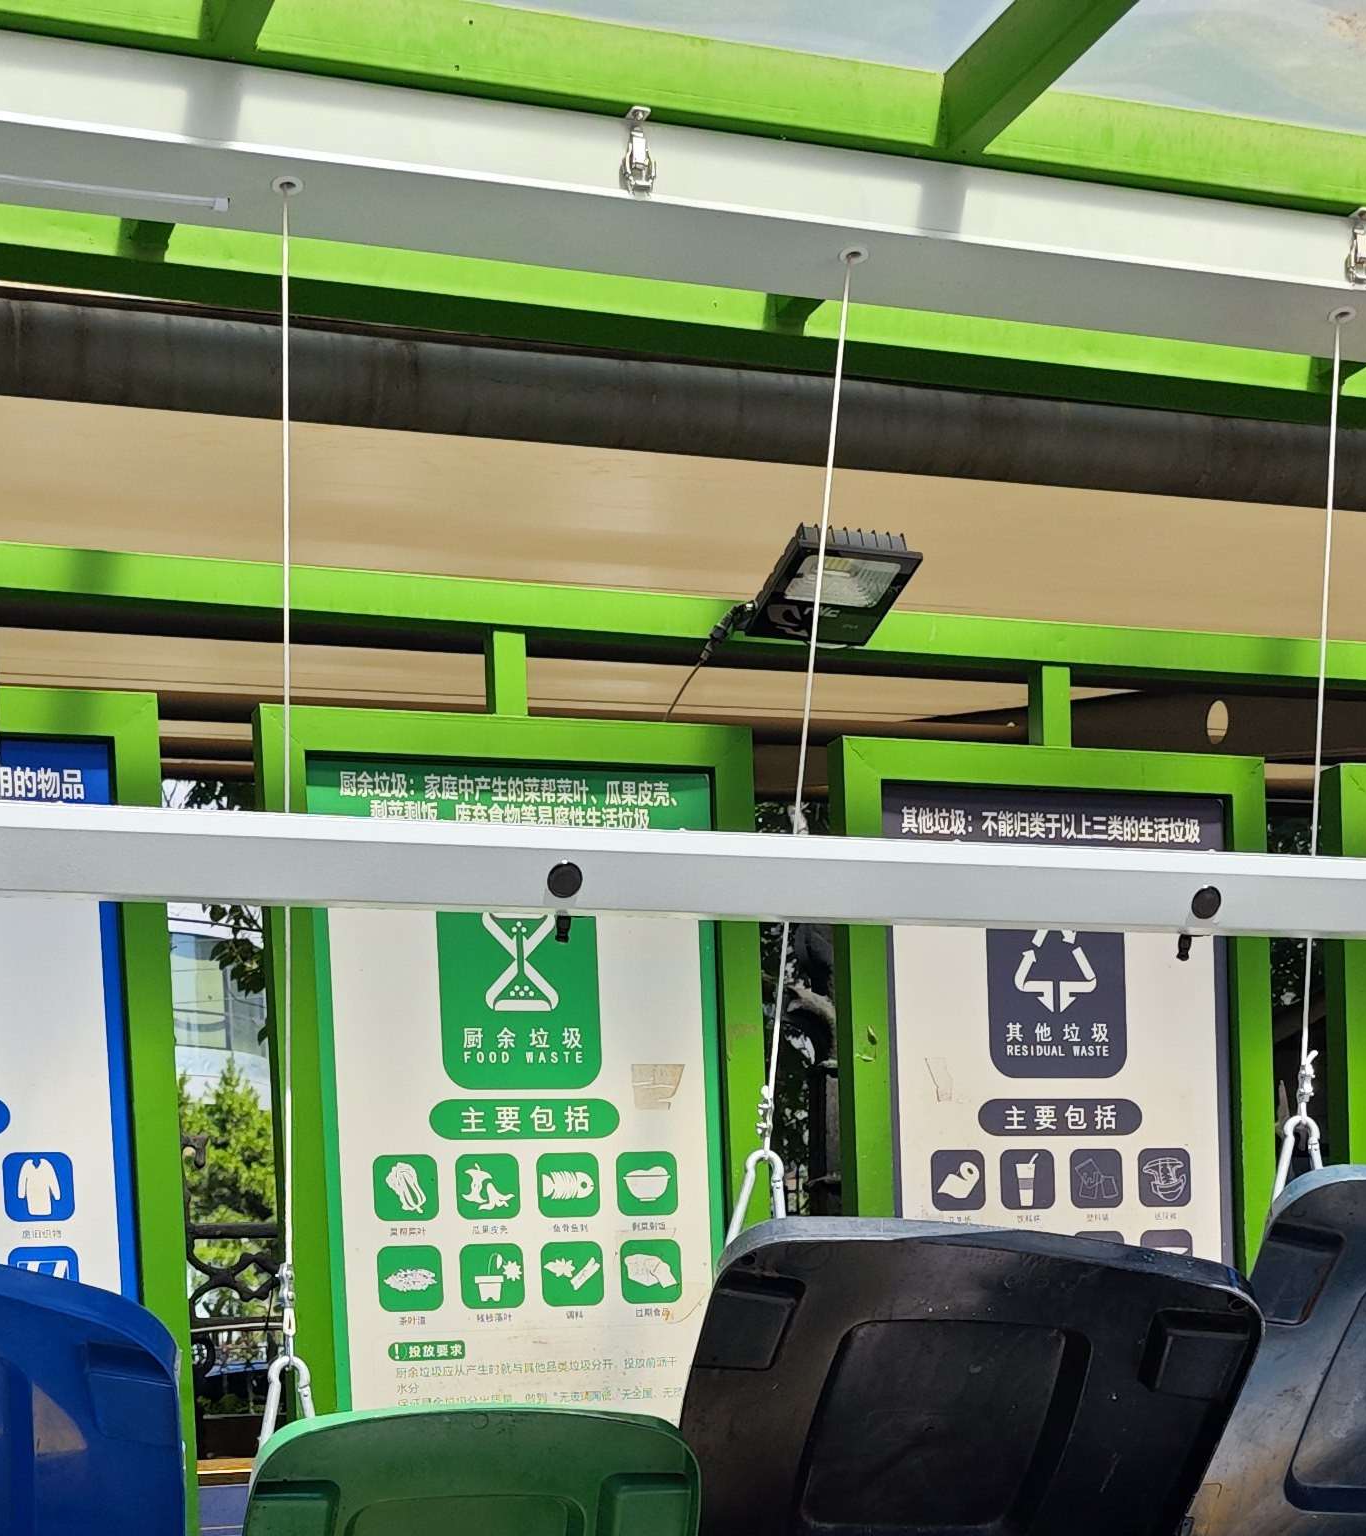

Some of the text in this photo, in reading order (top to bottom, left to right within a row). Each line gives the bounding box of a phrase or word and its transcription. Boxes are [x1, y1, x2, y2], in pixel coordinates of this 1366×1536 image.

[901, 806, 1200, 844] 其他垃圾：不能归类于以上三类的生活垃圾
[463, 1028, 583, 1050] 厨余垃圾
[1006, 1023, 1109, 1043] 其他垃圾
[464, 1051, 584, 1064] FOOD WASTE
[1006, 1044, 1110, 1058] RESIDUAL WASTE
[460, 1106, 590, 1134] 主要包括
[1004, 1105, 1117, 1131] 主要包括
[408, 1343, 463, 1359] 投放要求
